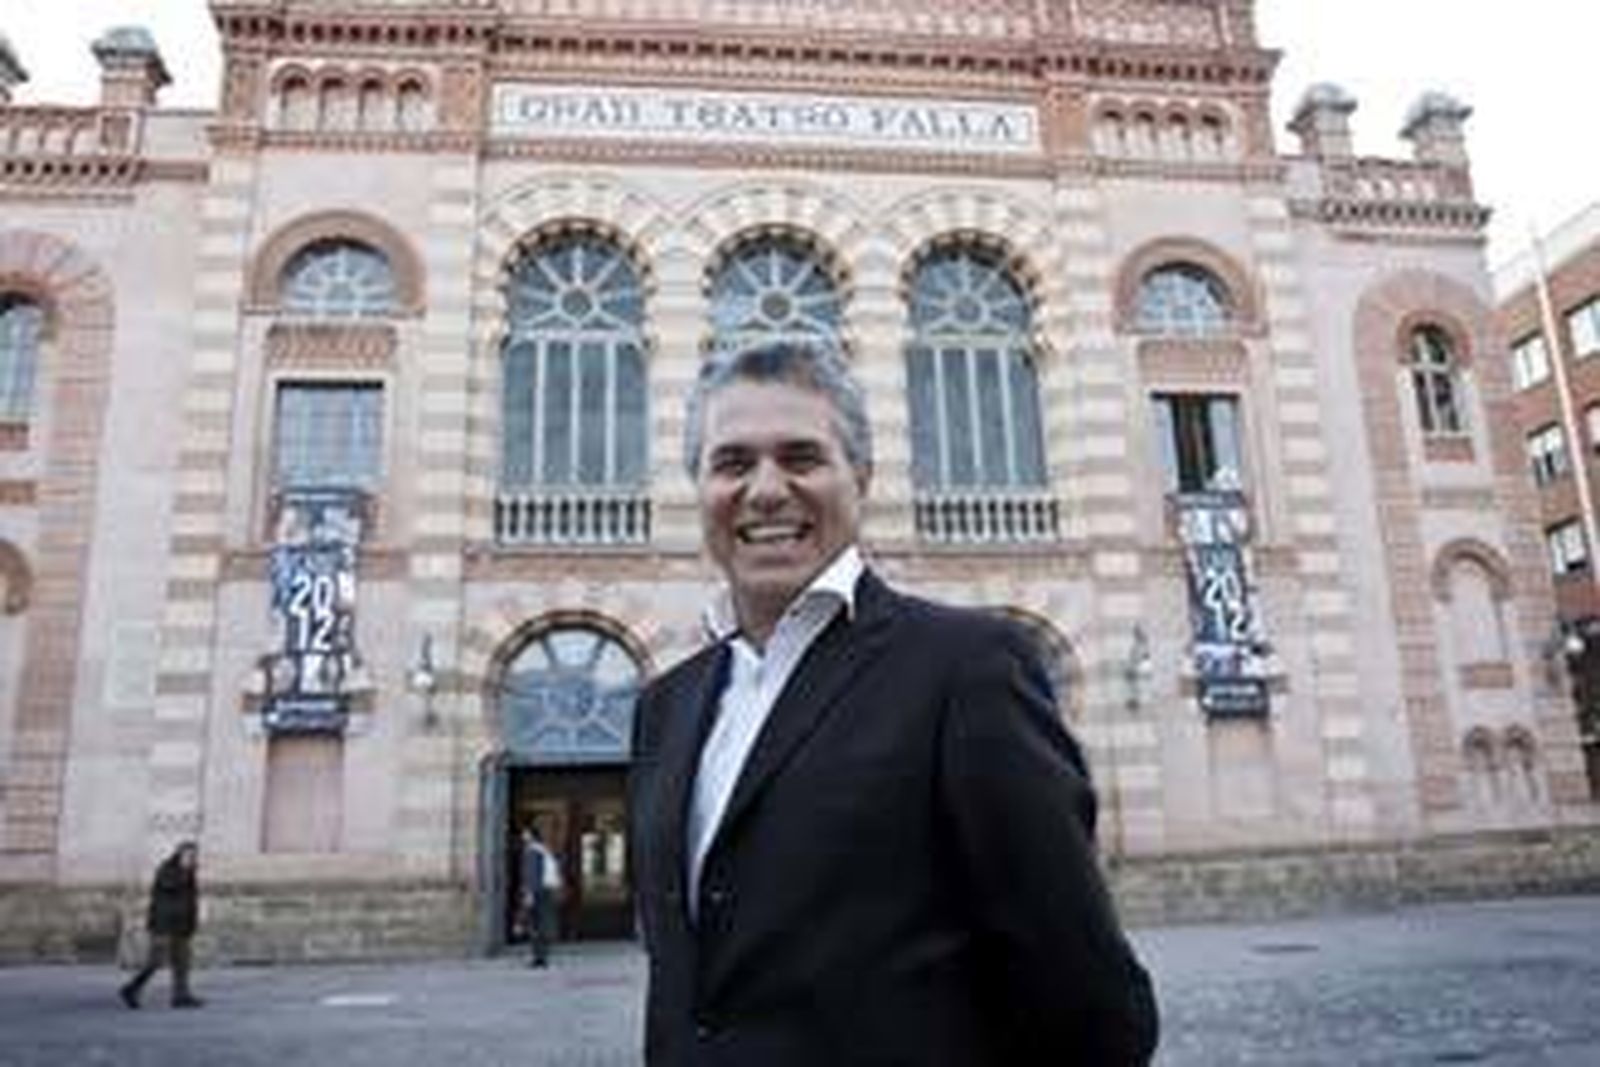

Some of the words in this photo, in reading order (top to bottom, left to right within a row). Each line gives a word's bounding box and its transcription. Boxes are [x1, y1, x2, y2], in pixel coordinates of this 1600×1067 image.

[668, 100, 850, 130] TEATRO
[869, 107, 1015, 139] FALLA
[290, 574, 335, 618] 20
